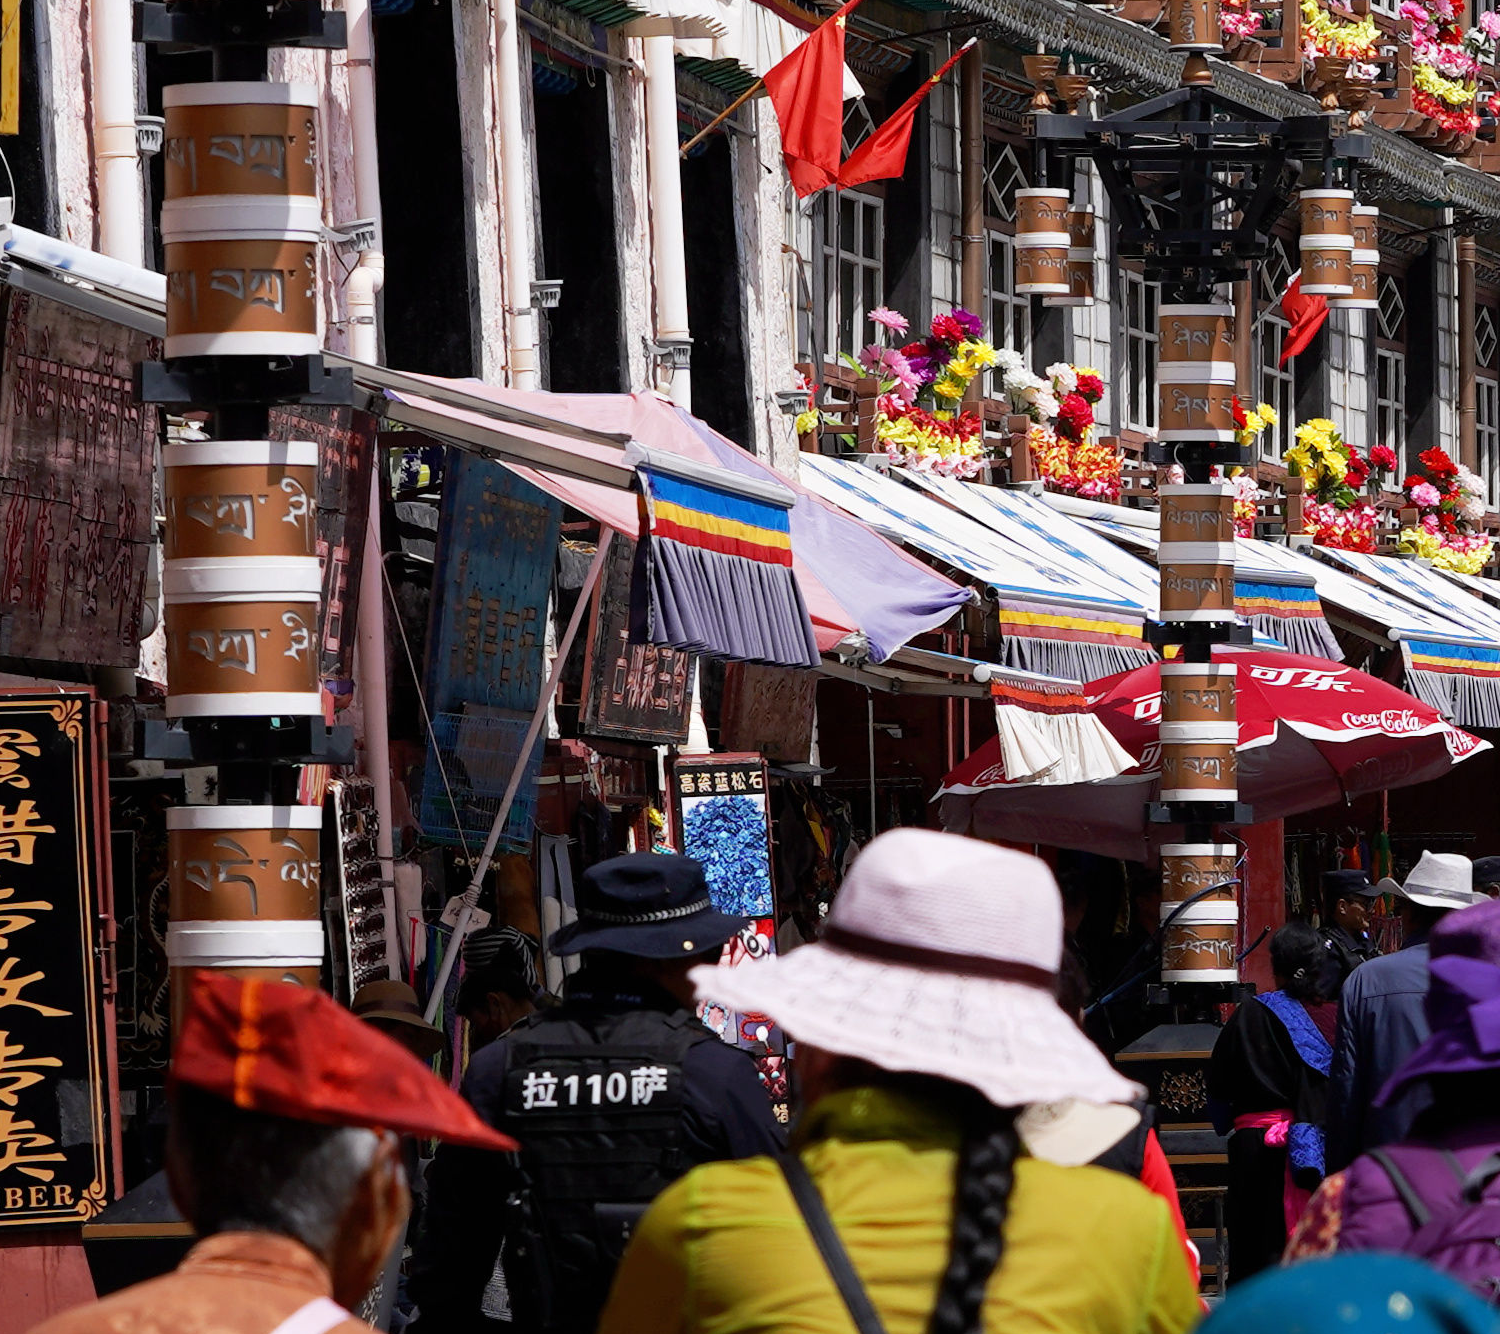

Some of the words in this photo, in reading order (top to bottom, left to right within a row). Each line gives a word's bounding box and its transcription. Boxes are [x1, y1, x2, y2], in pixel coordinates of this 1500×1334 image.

[678, 770, 764, 794] 高瓷蓝松石
[522, 1066, 668, 1110] 拉110萨
